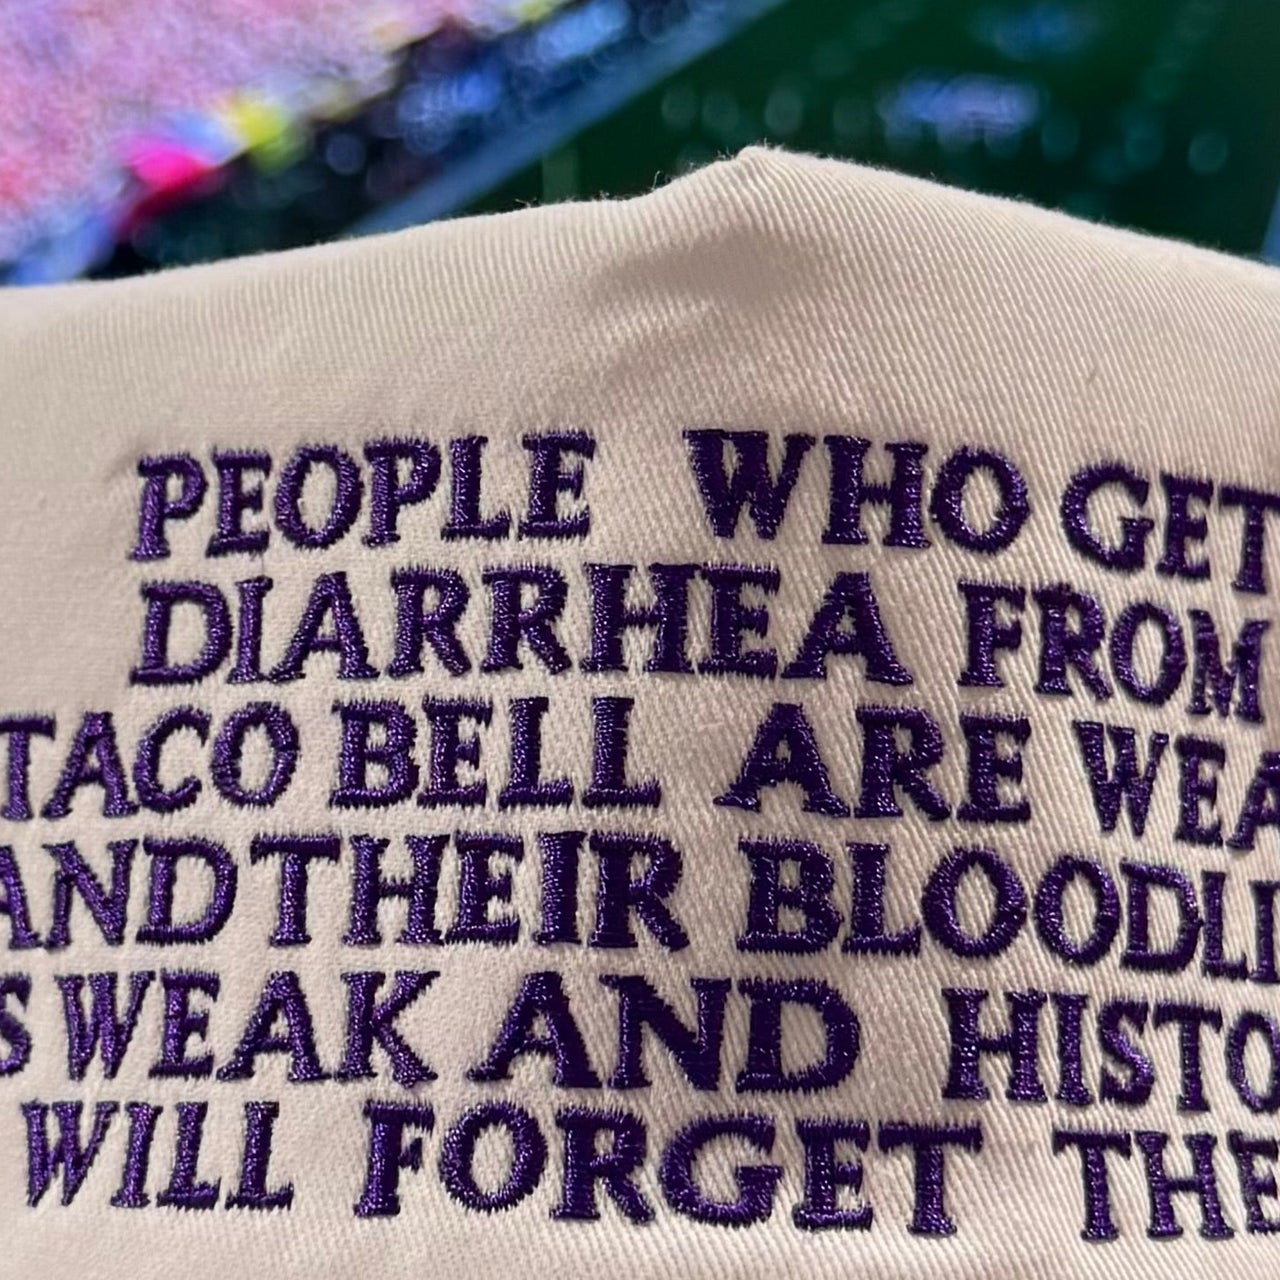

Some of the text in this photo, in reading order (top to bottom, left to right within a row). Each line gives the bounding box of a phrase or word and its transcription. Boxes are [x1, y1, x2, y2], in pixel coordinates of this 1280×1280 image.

[127, 427, 599, 564] PEOPLE
[680, 426, 1035, 559] WHO
[127, 559, 1274, 727] DIARRHEA FROM
[326, 693, 665, 814] BELL
[711, 699, 1033, 828] ARE
[248, 827, 692, 956] THEIR
[53, 967, 442, 1092] WEAK
[463, 968, 864, 1101] AND
[19, 1099, 296, 1213] WILL
[351, 1096, 986, 1239] FORGET
